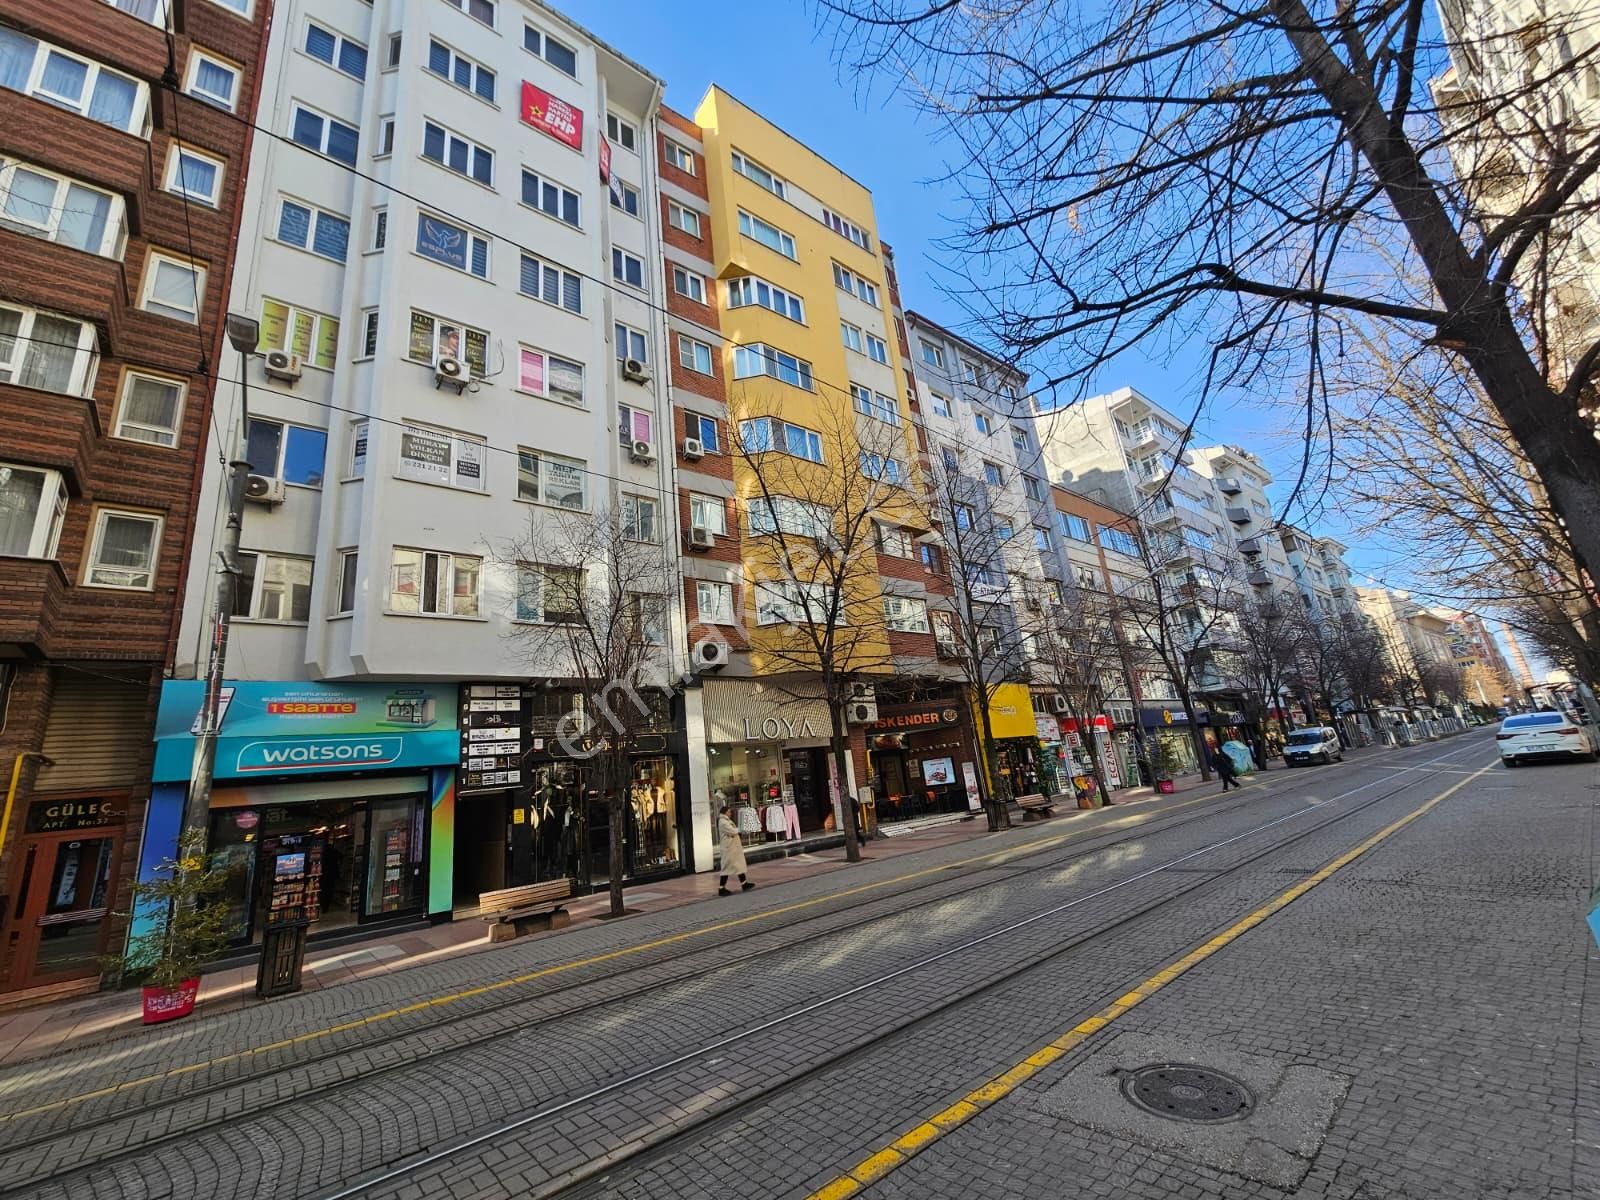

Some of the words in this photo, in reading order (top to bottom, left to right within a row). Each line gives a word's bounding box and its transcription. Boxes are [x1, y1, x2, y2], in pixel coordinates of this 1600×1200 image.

[545, 111, 576, 135] EHP
[409, 443, 445, 456] VOLKAN
[271, 704, 278, 713] 1
[744, 717, 816, 741] LOYA
[262, 741, 384, 763] watsons
[1103, 740, 1118, 779] ECZANE
